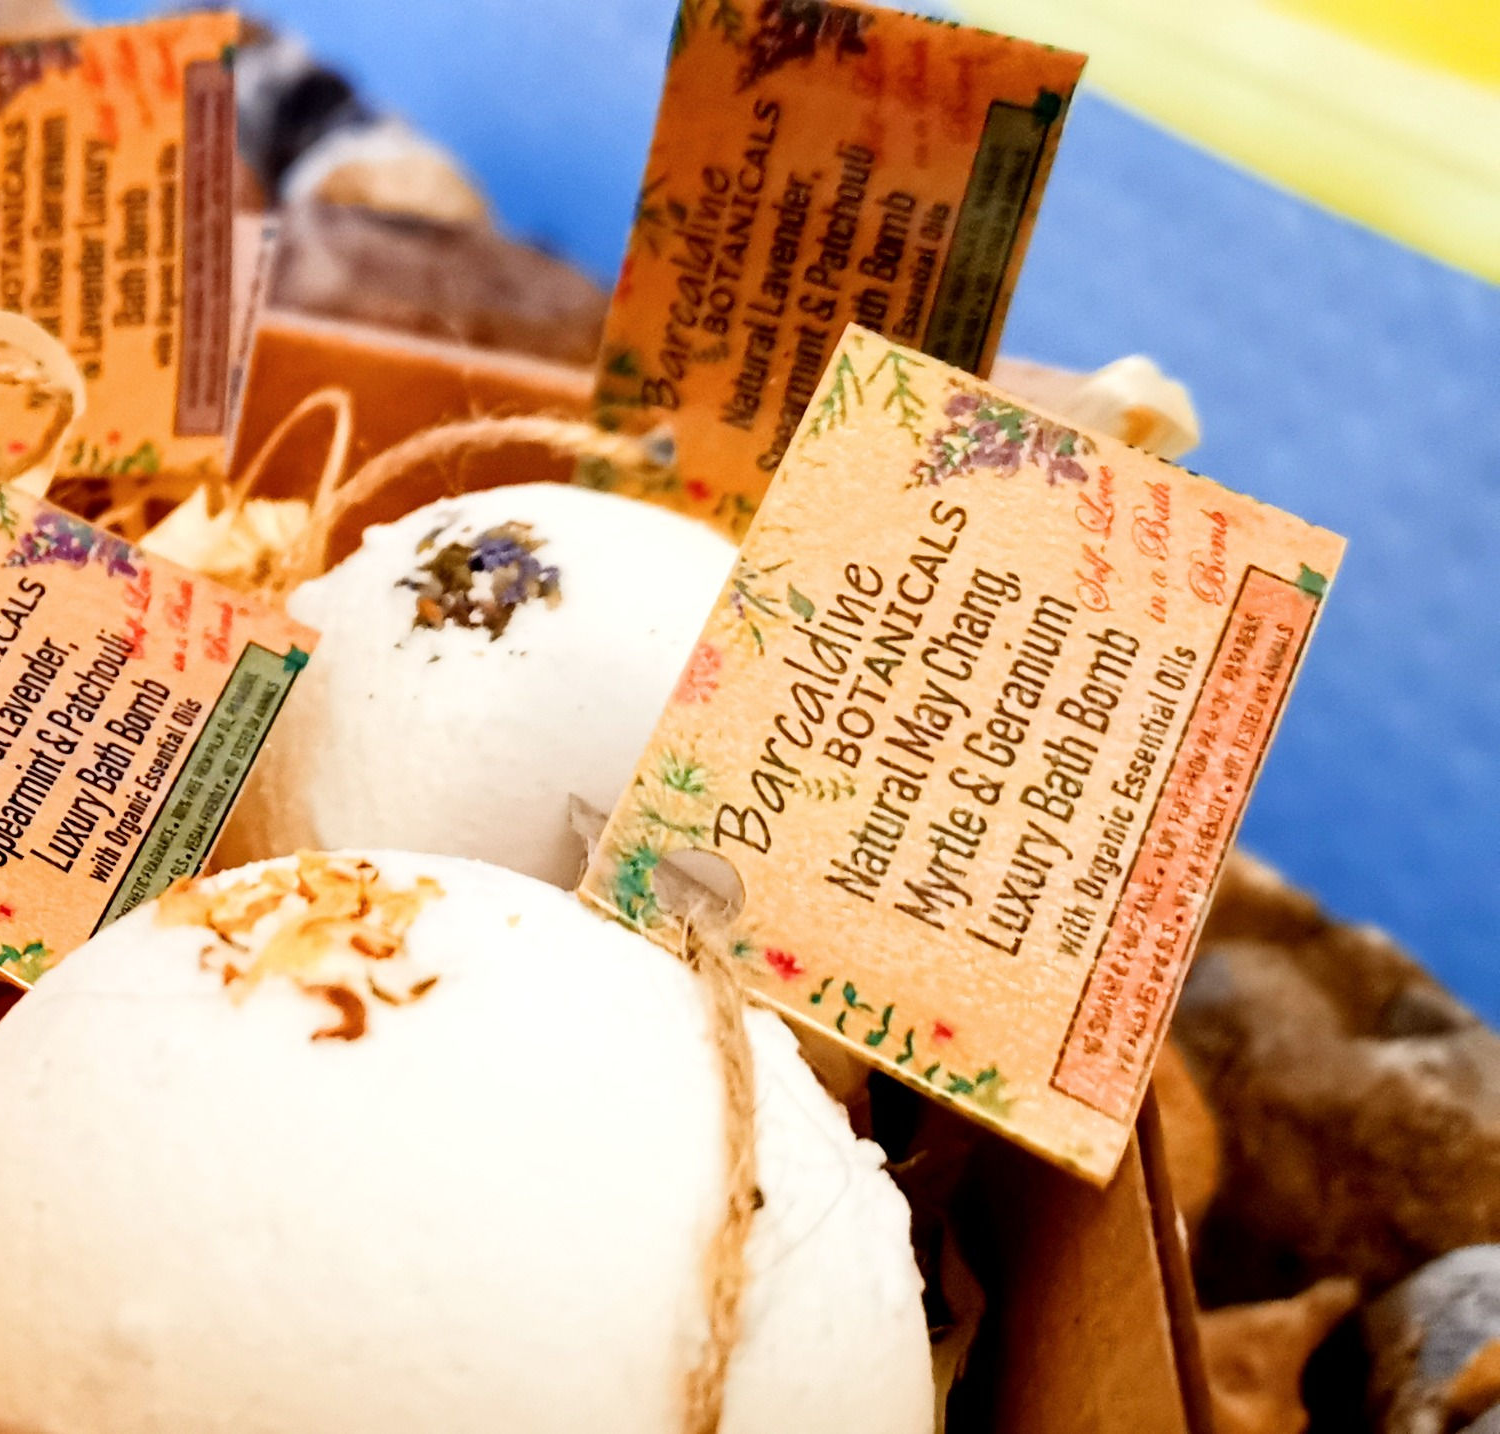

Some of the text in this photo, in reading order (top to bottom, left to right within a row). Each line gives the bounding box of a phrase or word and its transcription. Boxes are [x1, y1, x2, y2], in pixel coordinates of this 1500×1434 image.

[702, 99, 781, 335] BOTANICALS
[804, 141, 876, 291] Patchouli
[859, 191, 917, 283] Bomb
[641, 165, 730, 411] Barcaldine
[800, 295, 838, 321] &
[719, 318, 778, 431] Natural
[1188, 509, 1229, 606] Bomb
[822, 500, 967, 769] BOTANICALS
[1155, 645, 1197, 691] Oils
[46, 628, 135, 737] Patchouli
[104, 678, 171, 745] Bomb
[171, 698, 202, 727] Oils
[713, 562, 884, 854] Barcaldine
[37, 728, 79, 755] &
[76, 742, 135, 795] Bath
[135, 724, 186, 792] Essential
[824, 568, 1022, 902] Natural May Chang,
[894, 594, 1078, 930] Myrtle & Geranium
[1111, 690, 1179, 801] Essential
[30, 787, 116, 873] Luxury
[104, 790, 152, 847] Organic
[966, 628, 1140, 956] Luxury Bath Bomb
[89, 846, 122, 884] with
[1073, 806, 1134, 900] Organic
[1057, 904, 1096, 958] with
